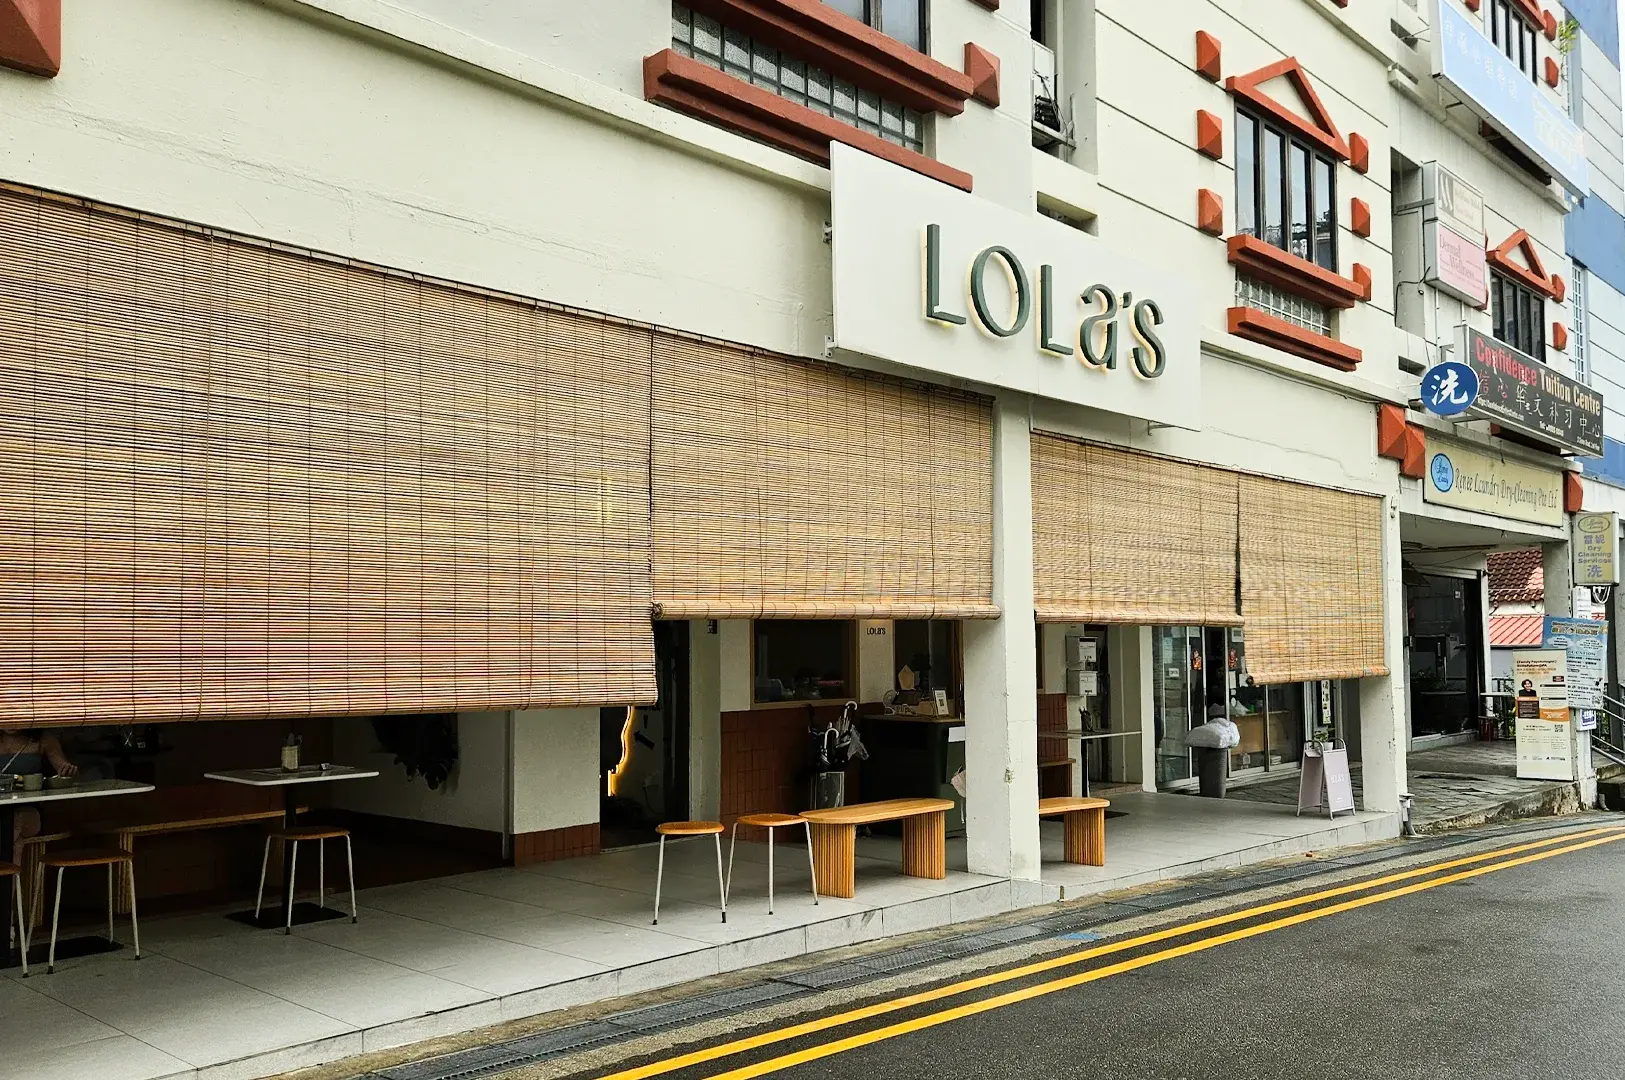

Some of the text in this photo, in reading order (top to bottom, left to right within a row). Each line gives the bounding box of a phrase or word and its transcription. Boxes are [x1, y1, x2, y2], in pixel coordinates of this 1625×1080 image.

[1430, 368, 1469, 406] 洗
[1475, 336, 1601, 417] Confidence Tuition Centre
[1455, 467, 1473, 494] Renee
[1474, 473, 1500, 505] Laundry
